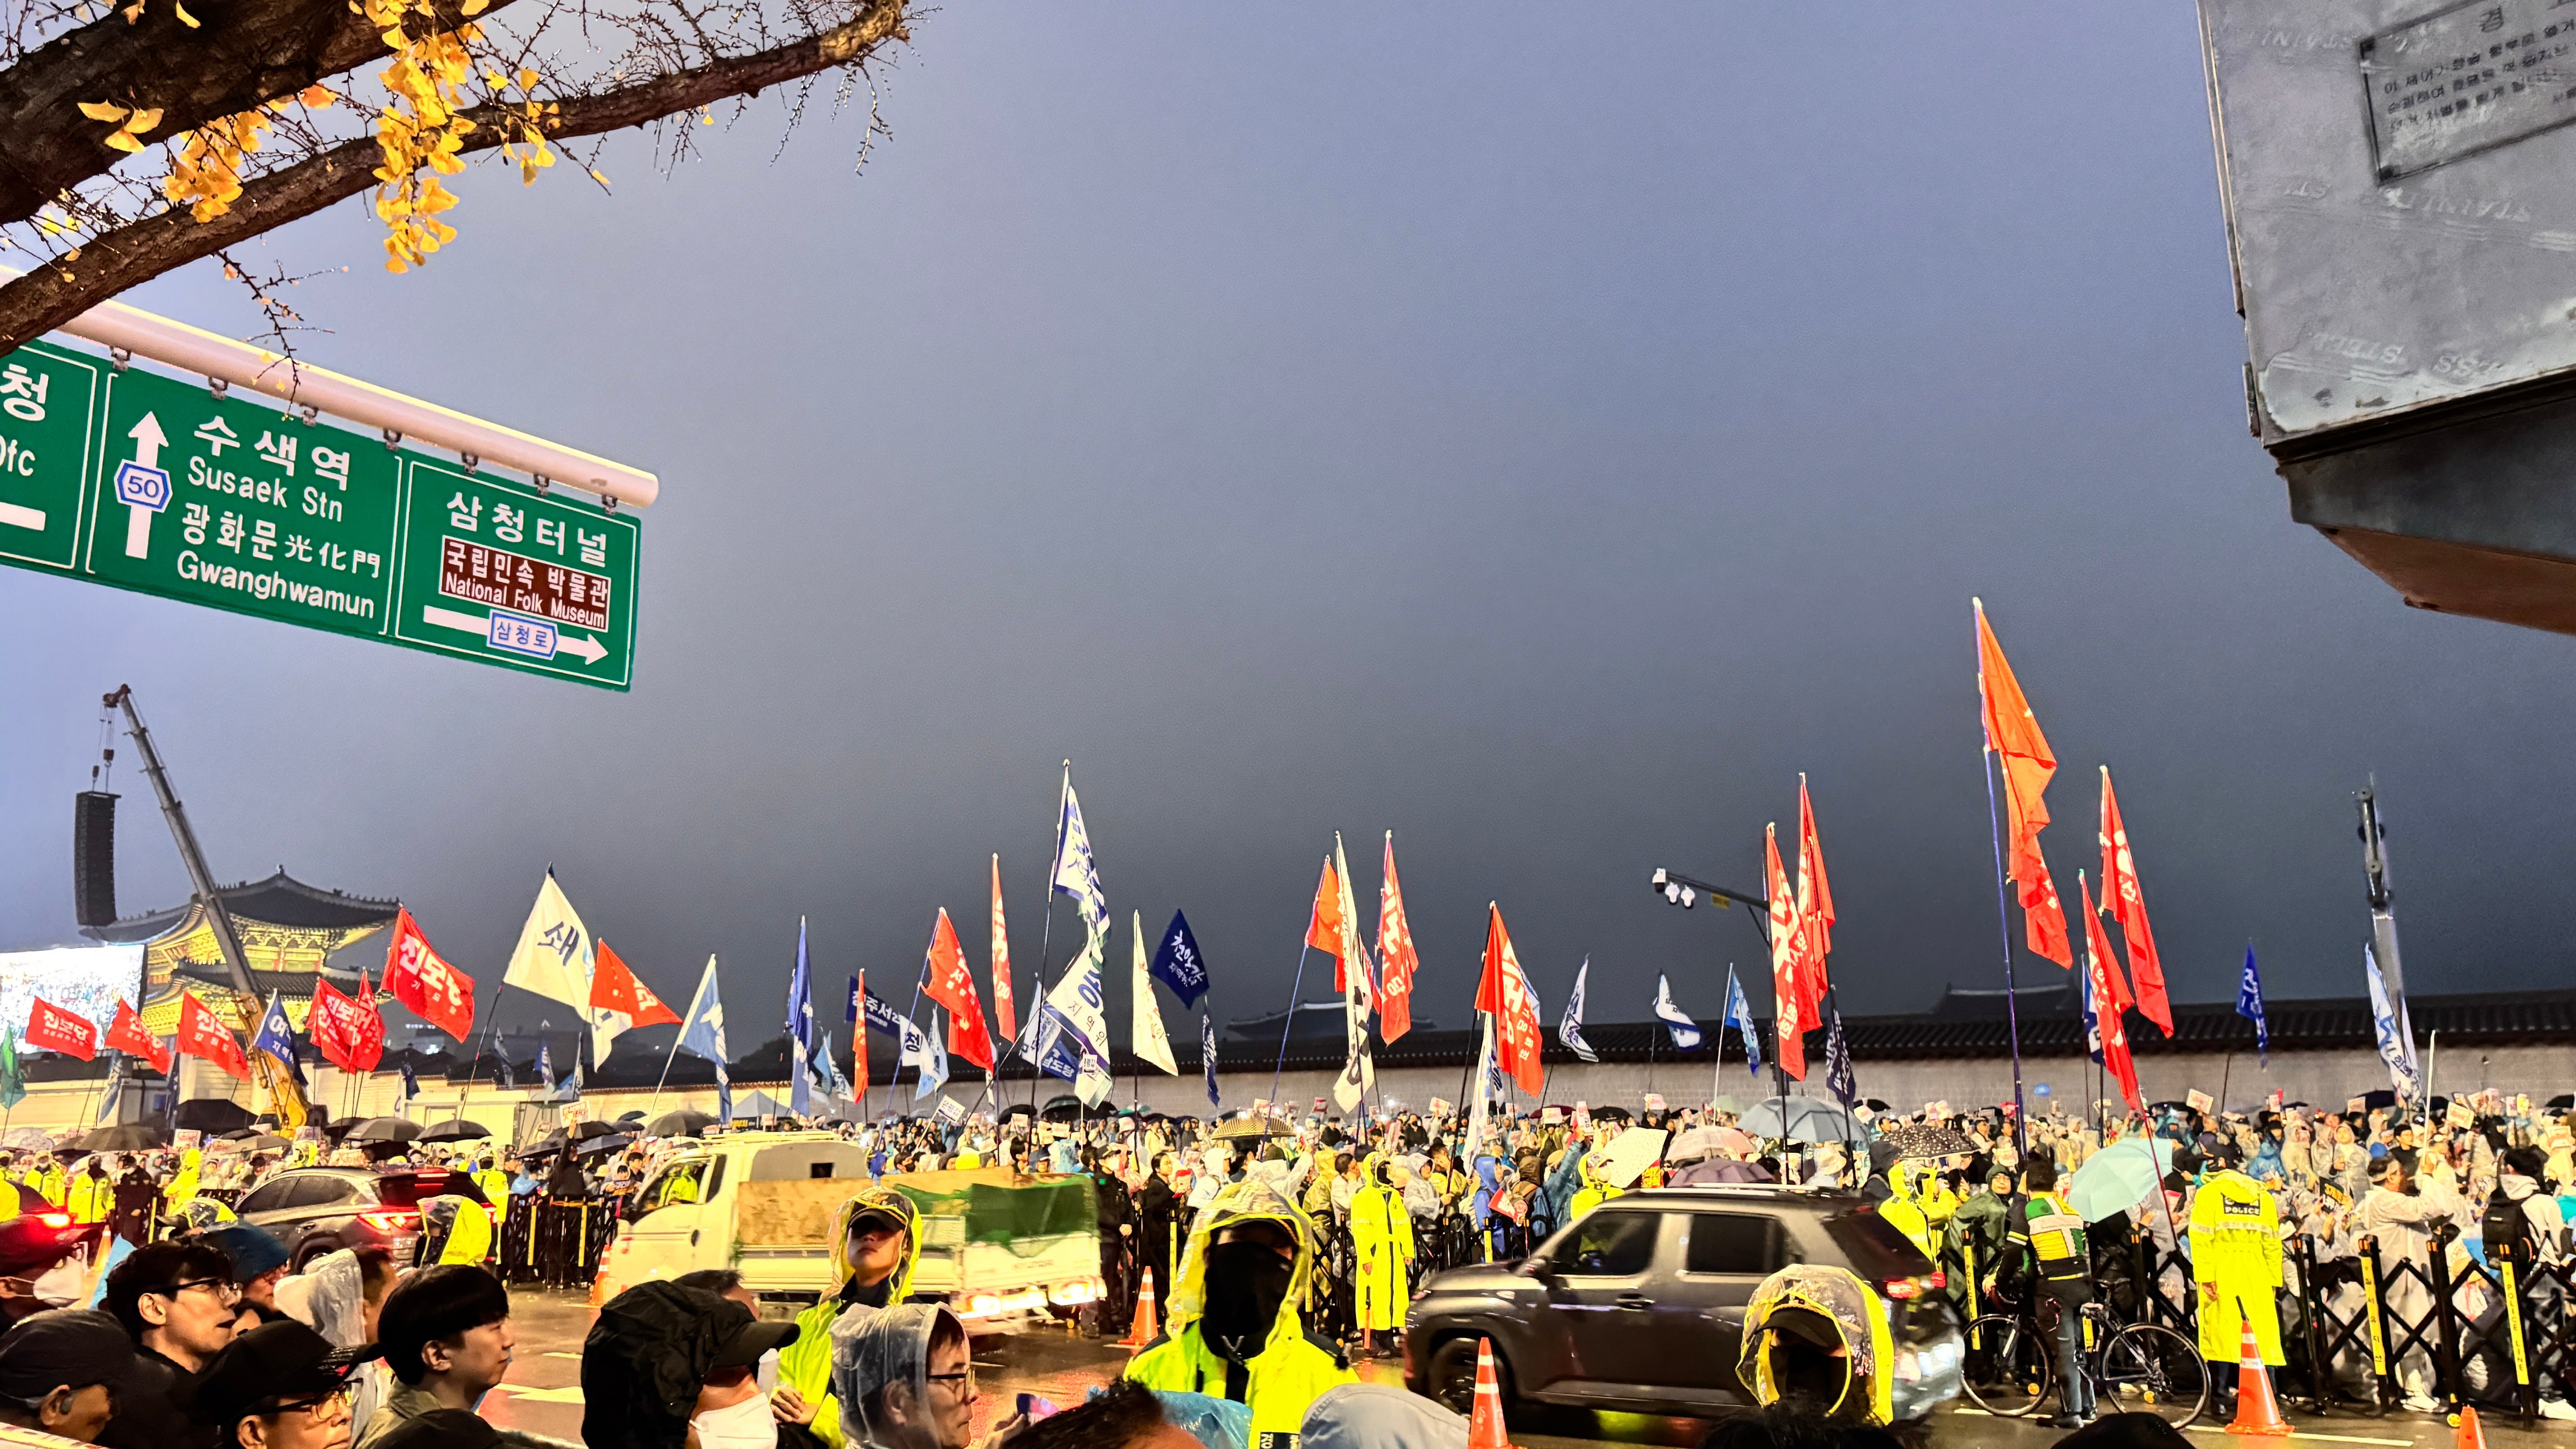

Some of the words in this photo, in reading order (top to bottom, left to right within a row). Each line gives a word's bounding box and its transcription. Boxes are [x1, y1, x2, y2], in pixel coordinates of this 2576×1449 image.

[0, 363, 49, 421] 청
[193, 415, 350, 491] 수색역
[127, 476, 160, 499] 50
[188, 456, 287, 508] Susaek
[302, 487, 343, 522] Stn
[182, 502, 277, 561] 광화문
[284, 534, 380, 578] 光化門
[447, 492, 607, 568] 삼청터널
[177, 550, 375, 619] Gwanghwamun
[446, 572, 506, 605] National
[514, 589, 543, 614] Folk
[550, 598, 605, 629] Museum
[447, 541, 534, 590] 국립민속
[548, 567, 608, 608] 박물관
[497, 621, 548, 648] 삼청로
[2507, 1284, 2519, 1331] POLICE
[2515, 1340, 2524, 1372] LINE
